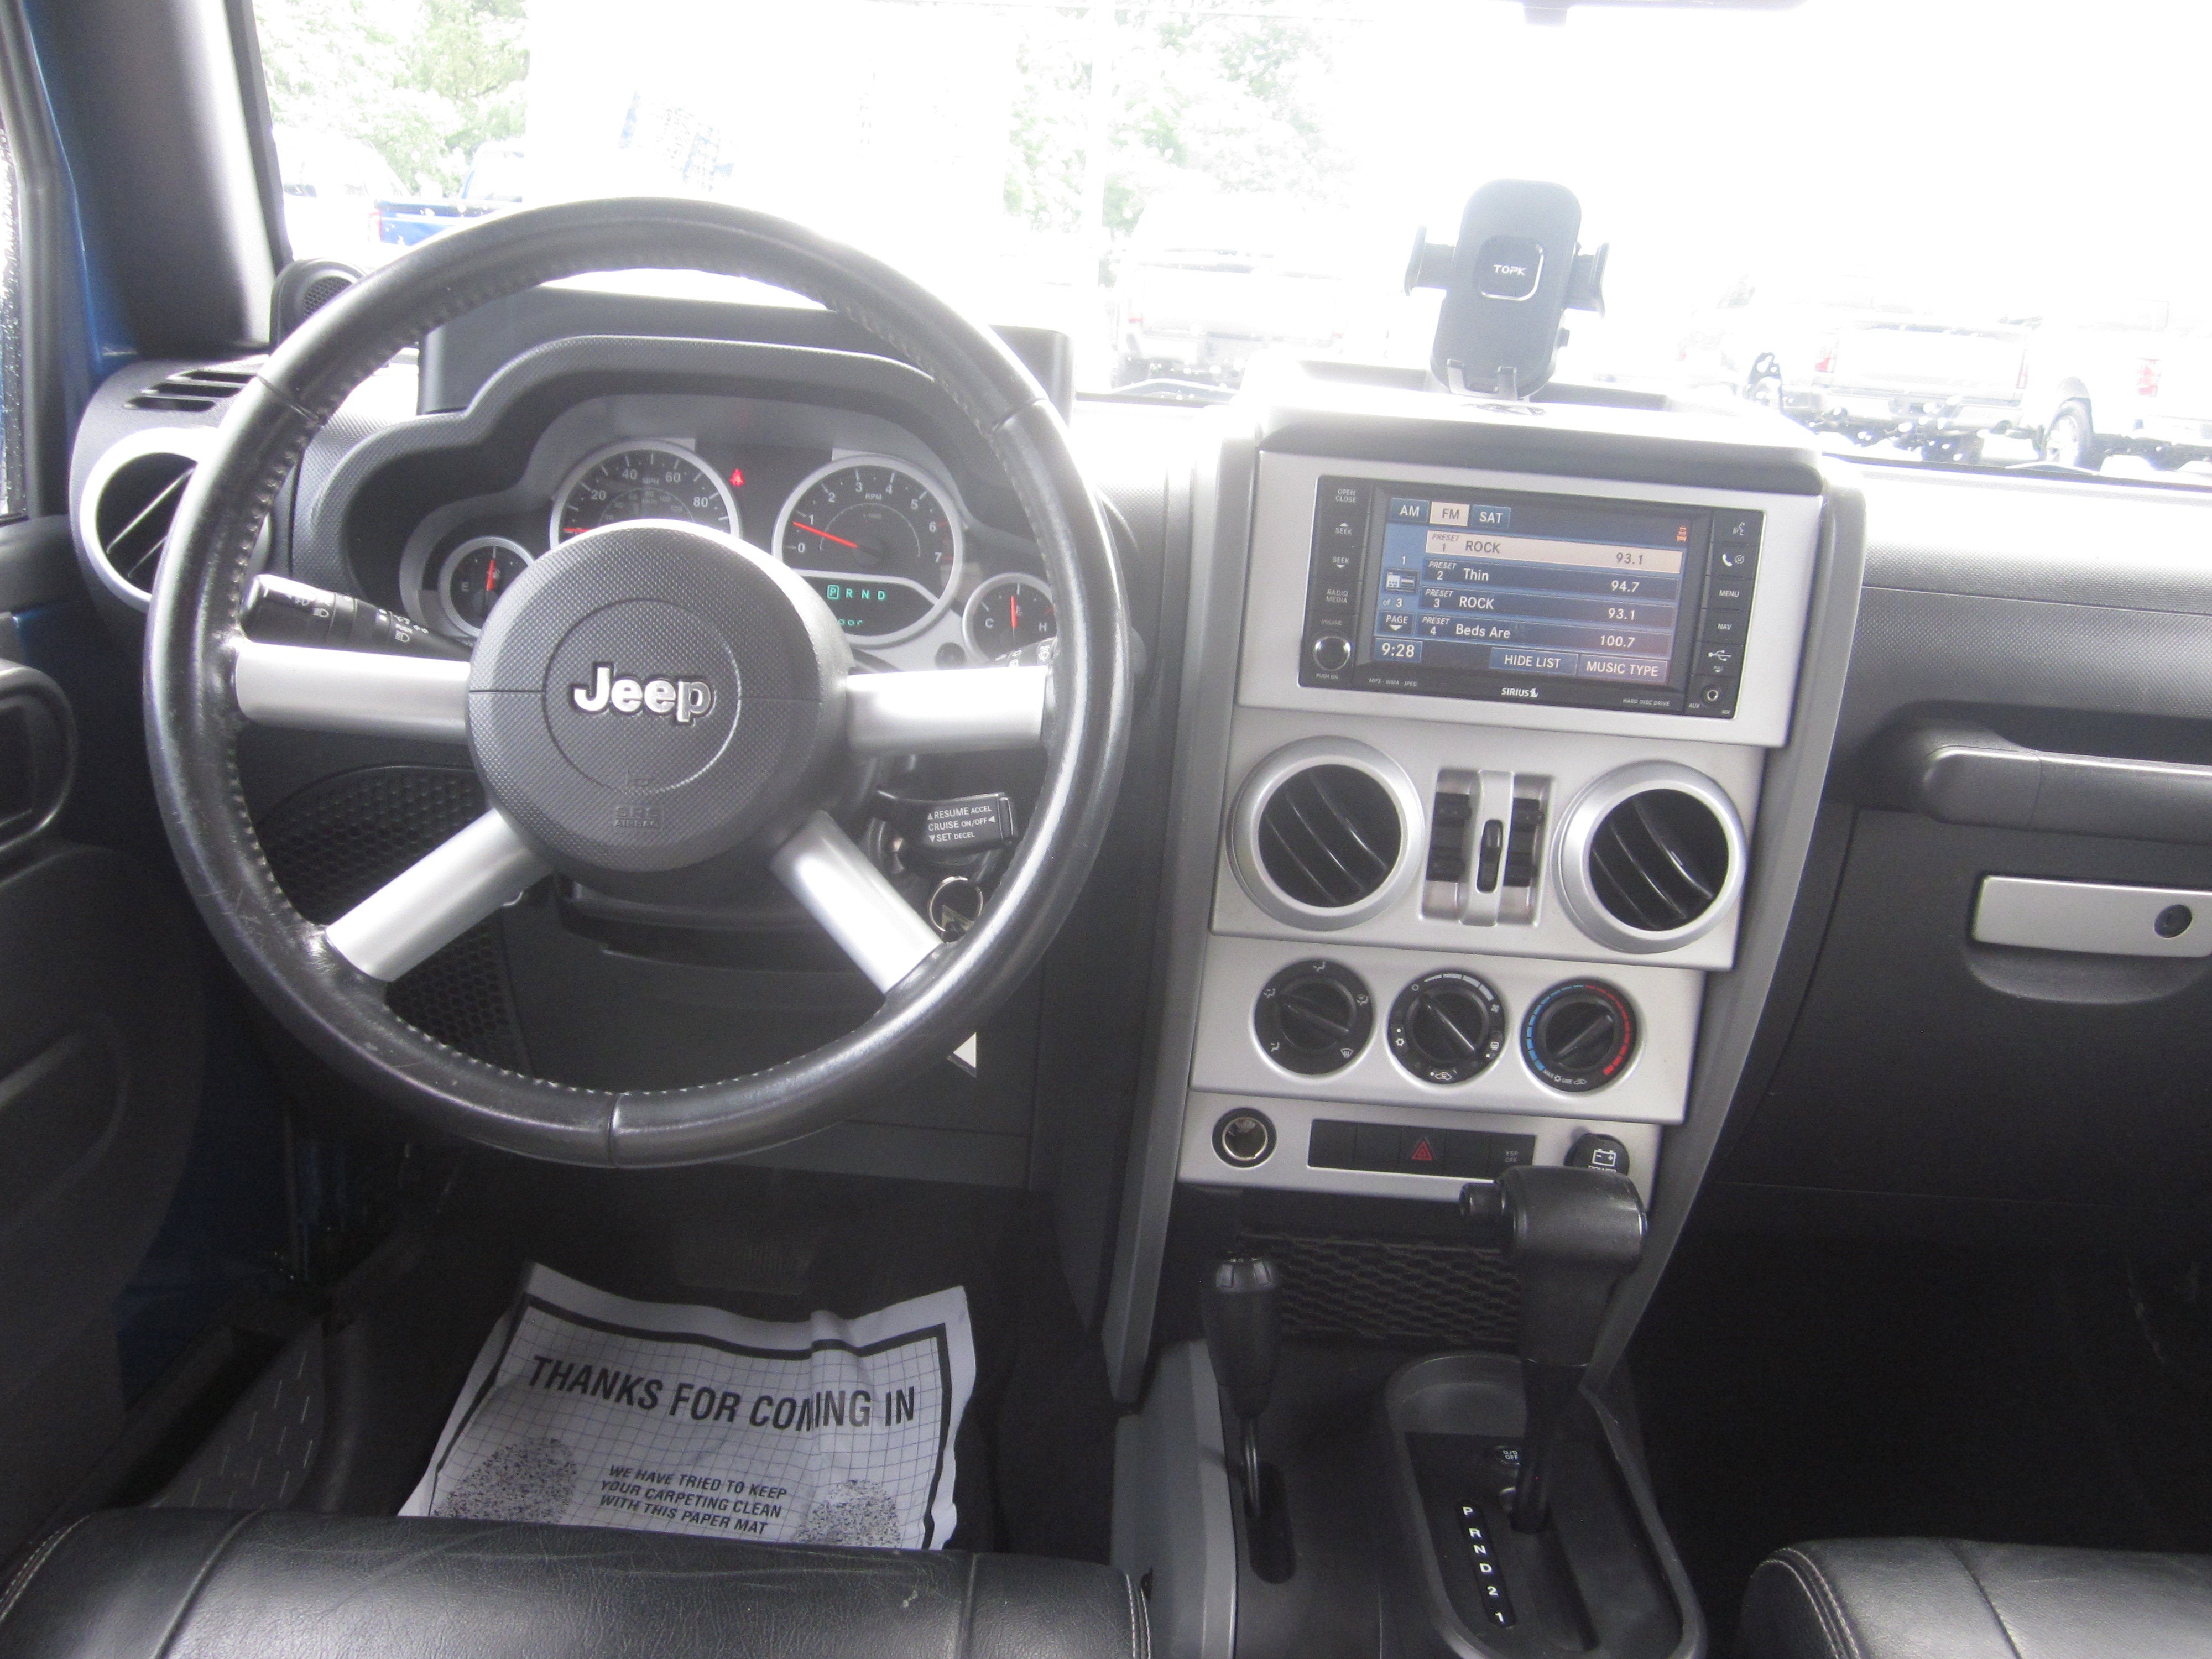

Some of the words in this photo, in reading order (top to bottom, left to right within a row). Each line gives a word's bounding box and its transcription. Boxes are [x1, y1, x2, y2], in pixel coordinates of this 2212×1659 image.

[1494, 264, 1526, 276] TOPK
[622, 469, 637, 480] 40
[666, 472, 681, 483] 60
[855, 482, 863, 492] 3
[885, 484, 892, 494] 4
[591, 489, 606, 500] 20
[828, 492, 836, 503] 2
[693, 497, 708, 508] 80
[911, 499, 918, 509] 5
[1399, 505, 1420, 517] AM
[1442, 508, 1460, 520] FM
[809, 514, 813, 524] 1
[1479, 512, 1503, 523] SAT
[929, 521, 936, 532] 6
[1432, 533, 1459, 542] PRESET
[798, 542, 805, 553] 0
[1442, 543, 1446, 552] 1
[1465, 540, 1500, 554] ROCK
[1616, 552, 1644, 565] 93.1
[935, 552, 942, 562] 7
[1402, 555, 1406, 565] 1
[1428, 561, 1457, 570] PRESET
[1437, 571, 1443, 580] 2
[1463, 568, 1489, 581] Thin
[1611, 580, 1640, 593] 94.7
[846, 588, 853, 598] R
[862, 589, 869, 599] N
[877, 590, 885, 600] D
[1425, 588, 1454, 597] PRESET
[1396, 598, 1402, 607] 3
[1433, 599, 1440, 608] 3
[1459, 596, 1494, 609] ROCK
[1608, 607, 1635, 621] 93.1
[985, 618, 994, 628] C
[1386, 614, 1408, 624] PAGE
[1422, 616, 1451, 625] PRESET
[1039, 622, 1047, 631] H
[1430, 626, 1436, 635] 4
[1455, 623, 1486, 637] Beds
[1489, 626, 1511, 639] Are
[1600, 635, 1635, 648] 100.7
[1382, 642, 1415, 658] 9:28
[1504, 654, 1533, 666] HIDE
[1536, 657, 1561, 669] LIST
[1586, 661, 1626, 674] MUSIC
[1630, 664, 1659, 677] TYPE
[573, 666, 712, 722] Jeep
[1501, 687, 1530, 697] SIRIUS
[933, 807, 969, 820] RESUME
[971, 805, 992, 815] ACCEL
[928, 820, 959, 831] CRUISE
[961, 817, 988, 827] ON/OFF
[936, 833, 952, 842] SET
[954, 831, 975, 840] DECEL
[529, 1355, 663, 1410] THANKS
[669, 1381, 741, 1423] FOR
[885, 1386, 914, 1427] IN
[609, 1465, 633, 1478] WE
[635, 1468, 676, 1485] HAVE
[679, 1474, 721, 1491] TRIED
[727, 1480, 745, 1493] TO
[749, 1483, 787, 1499] KEEP
[601, 1480, 641, 1495] YOUR
[644, 1488, 729, 1511] CARPETING
[733, 1499, 783, 1519] CLEAN
[600, 1495, 643, 1510] WITH
[644, 1503, 678, 1519] THIS
[681, 1510, 731, 1528] PAPER
[734, 1519, 769, 1535] MAT
[1462, 1506, 1473, 1515] P
[1469, 1528, 1481, 1538] R
[1473, 1545, 1487, 1554] N
[1479, 1563, 1493, 1573] D
[1487, 1585, 1499, 1596] 2
[1495, 1611, 1505, 1623] 1
